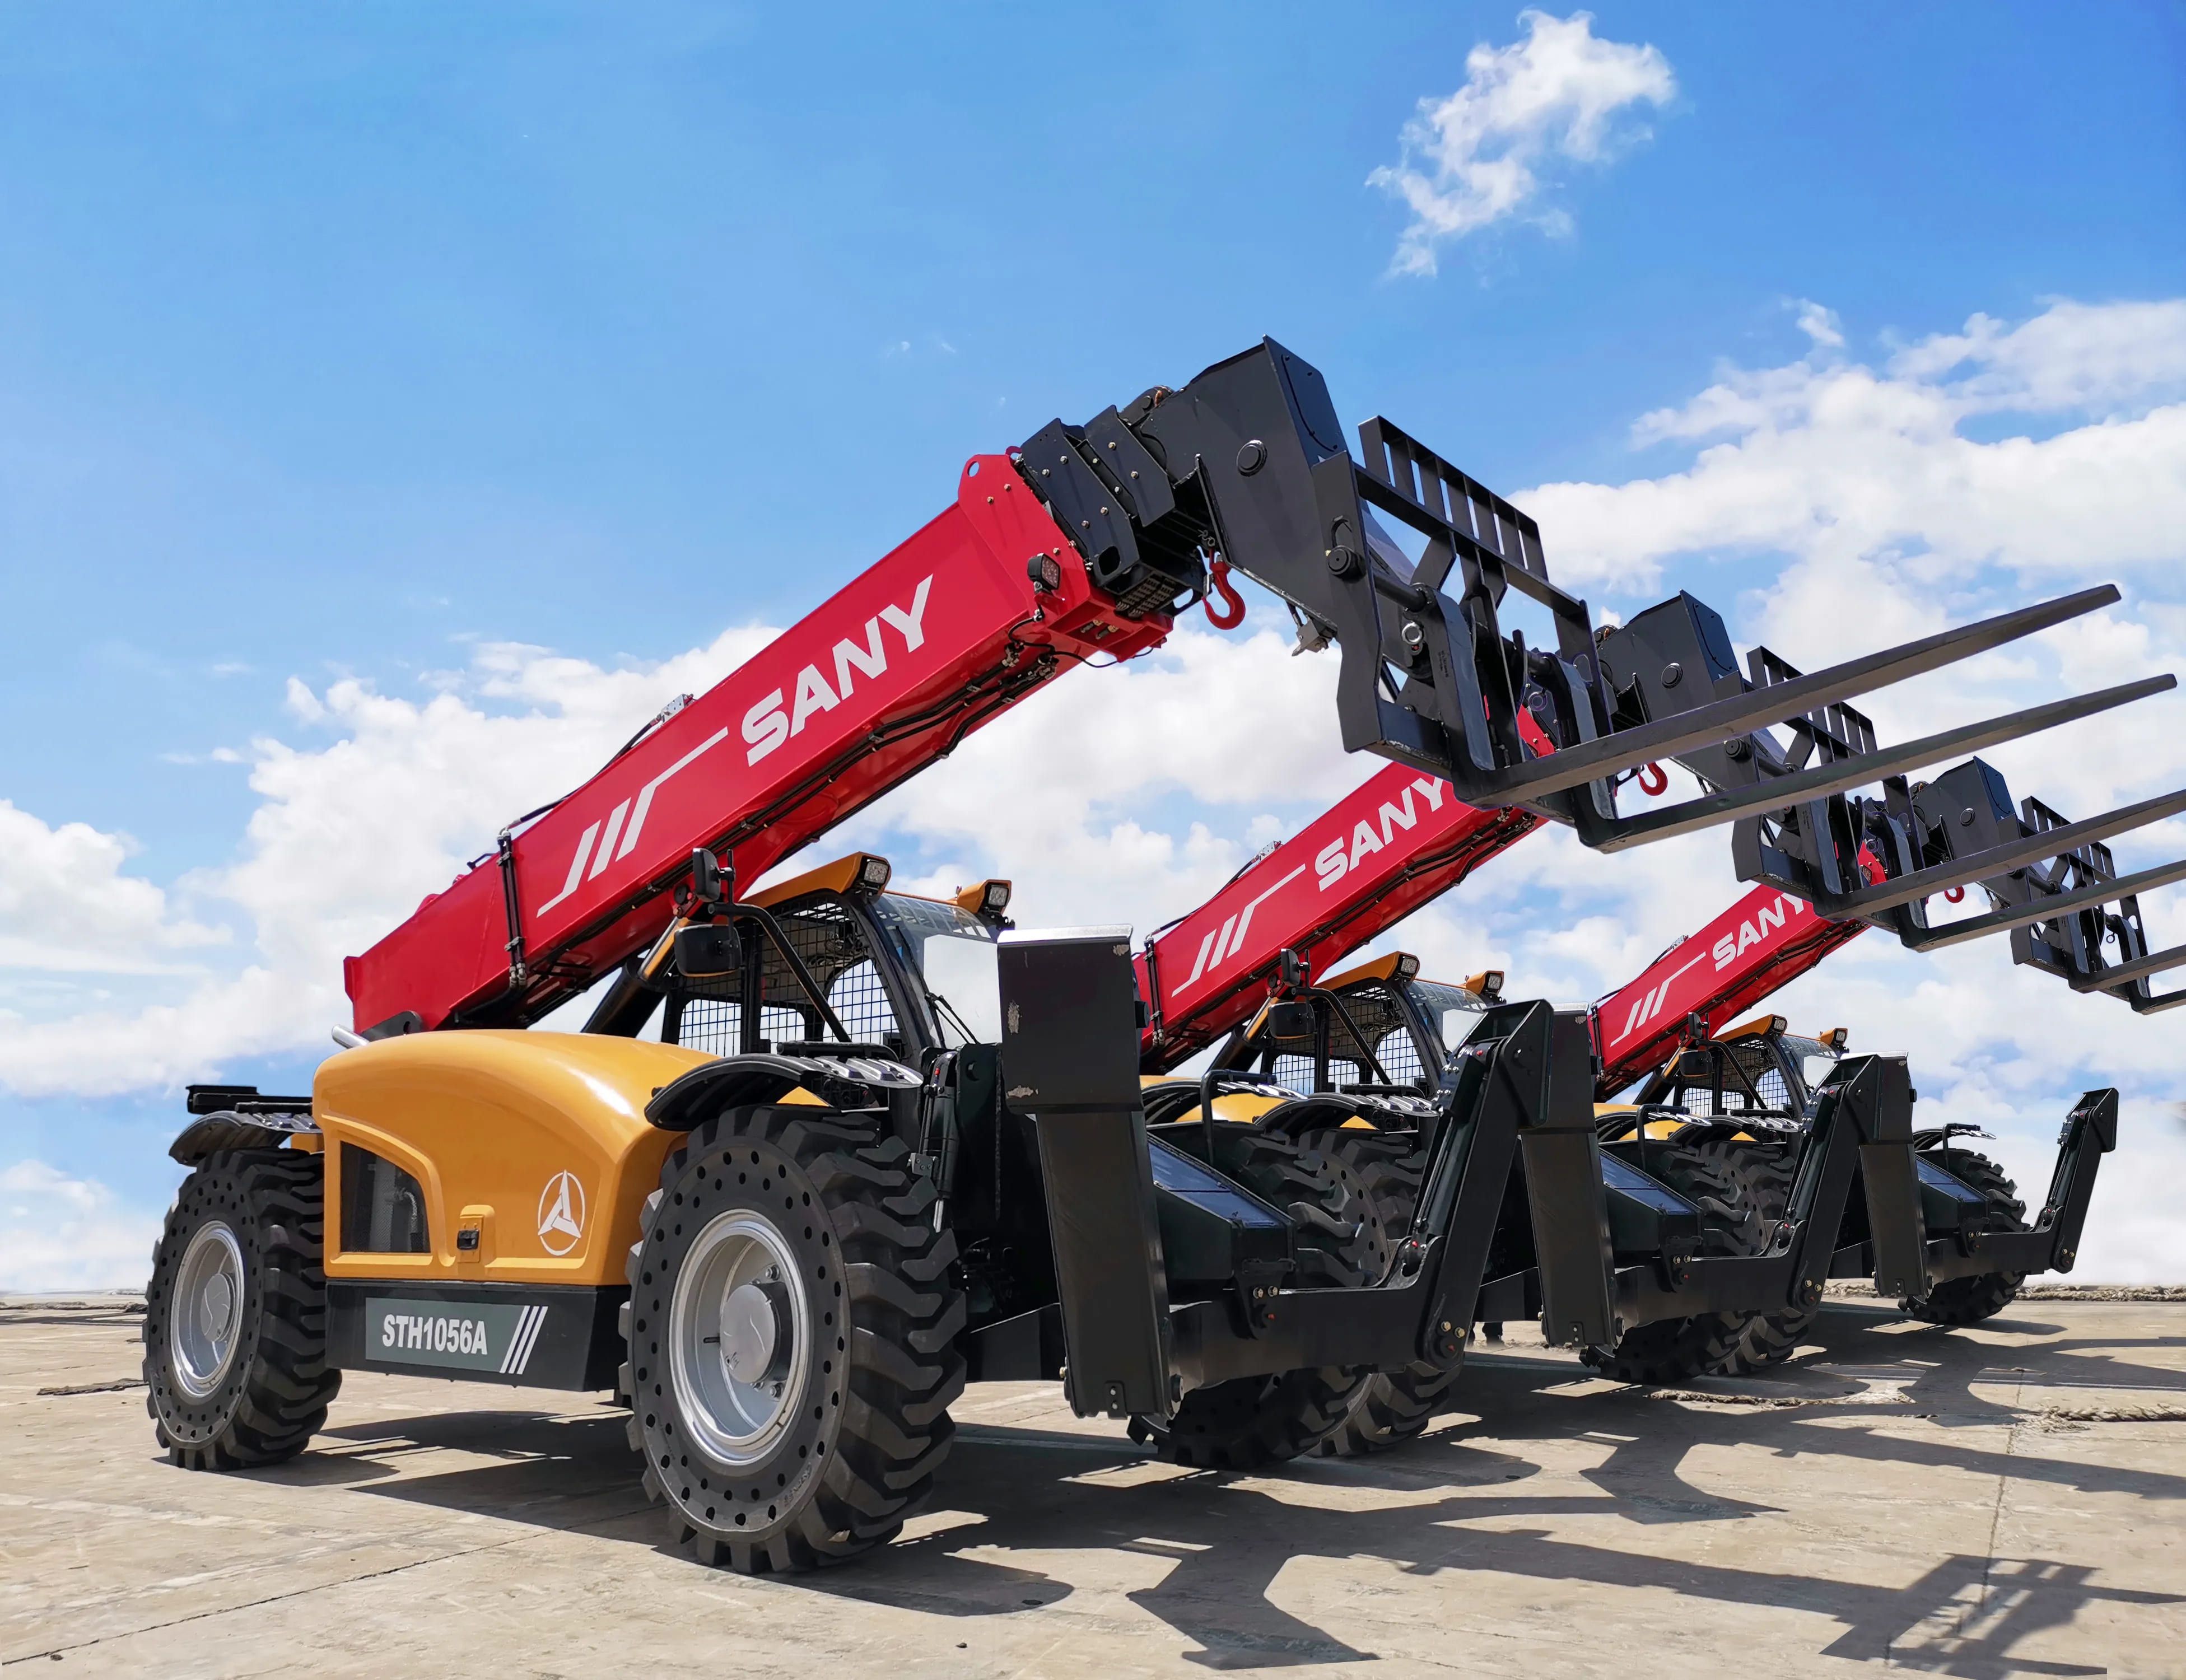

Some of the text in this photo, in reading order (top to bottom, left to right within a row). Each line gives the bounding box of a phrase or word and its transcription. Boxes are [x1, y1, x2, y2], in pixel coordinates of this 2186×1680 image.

[742, 573, 933, 767] SANY
[1315, 777, 1443, 892] SANY
[383, 1314, 488, 1355] STH1056A
